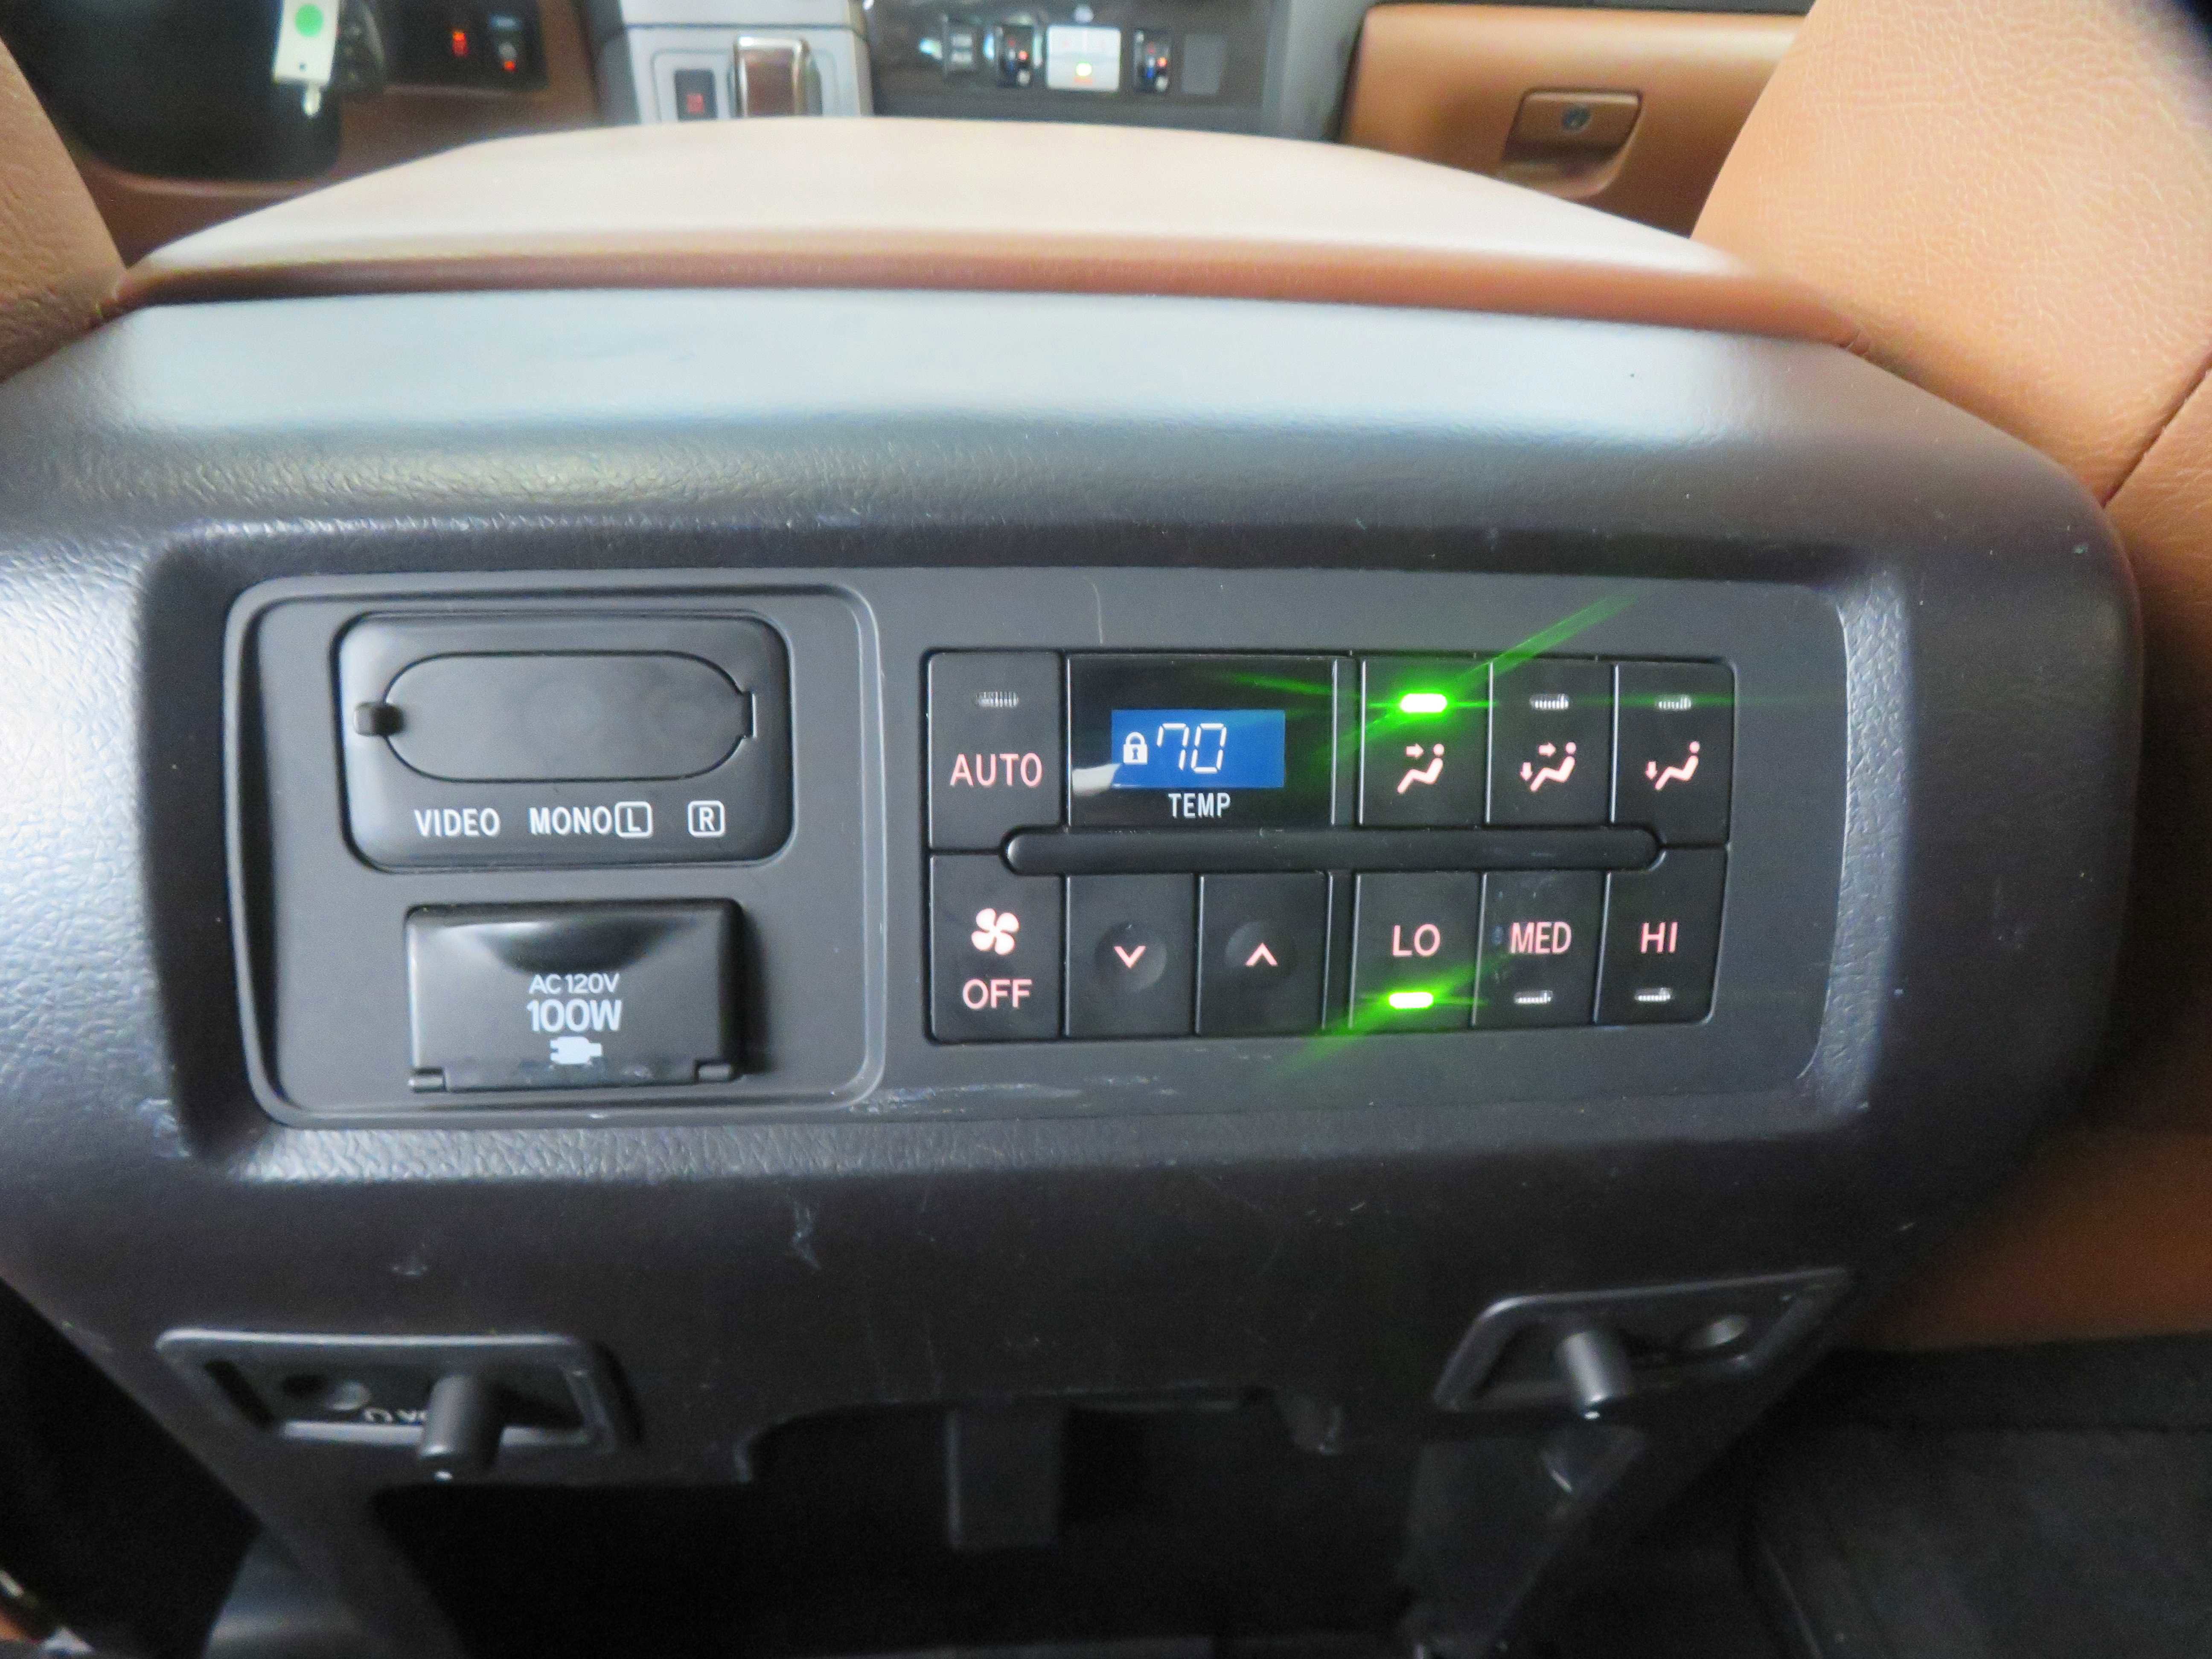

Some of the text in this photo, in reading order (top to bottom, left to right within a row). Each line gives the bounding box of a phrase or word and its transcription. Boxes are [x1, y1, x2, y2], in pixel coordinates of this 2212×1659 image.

[1156, 722, 1228, 774] 70
[949, 752, 1042, 787] AUTO
[413, 807, 501, 837] VIDEO
[529, 805, 613, 835] MONO
[1167, 792, 1231, 819] TEMP
[1392, 923, 1441, 958] LO
[1510, 921, 1572, 954] MED
[1640, 921, 1678, 954] HI
[962, 978, 1033, 1010] OFF
[526, 998, 623, 1032] 100W
